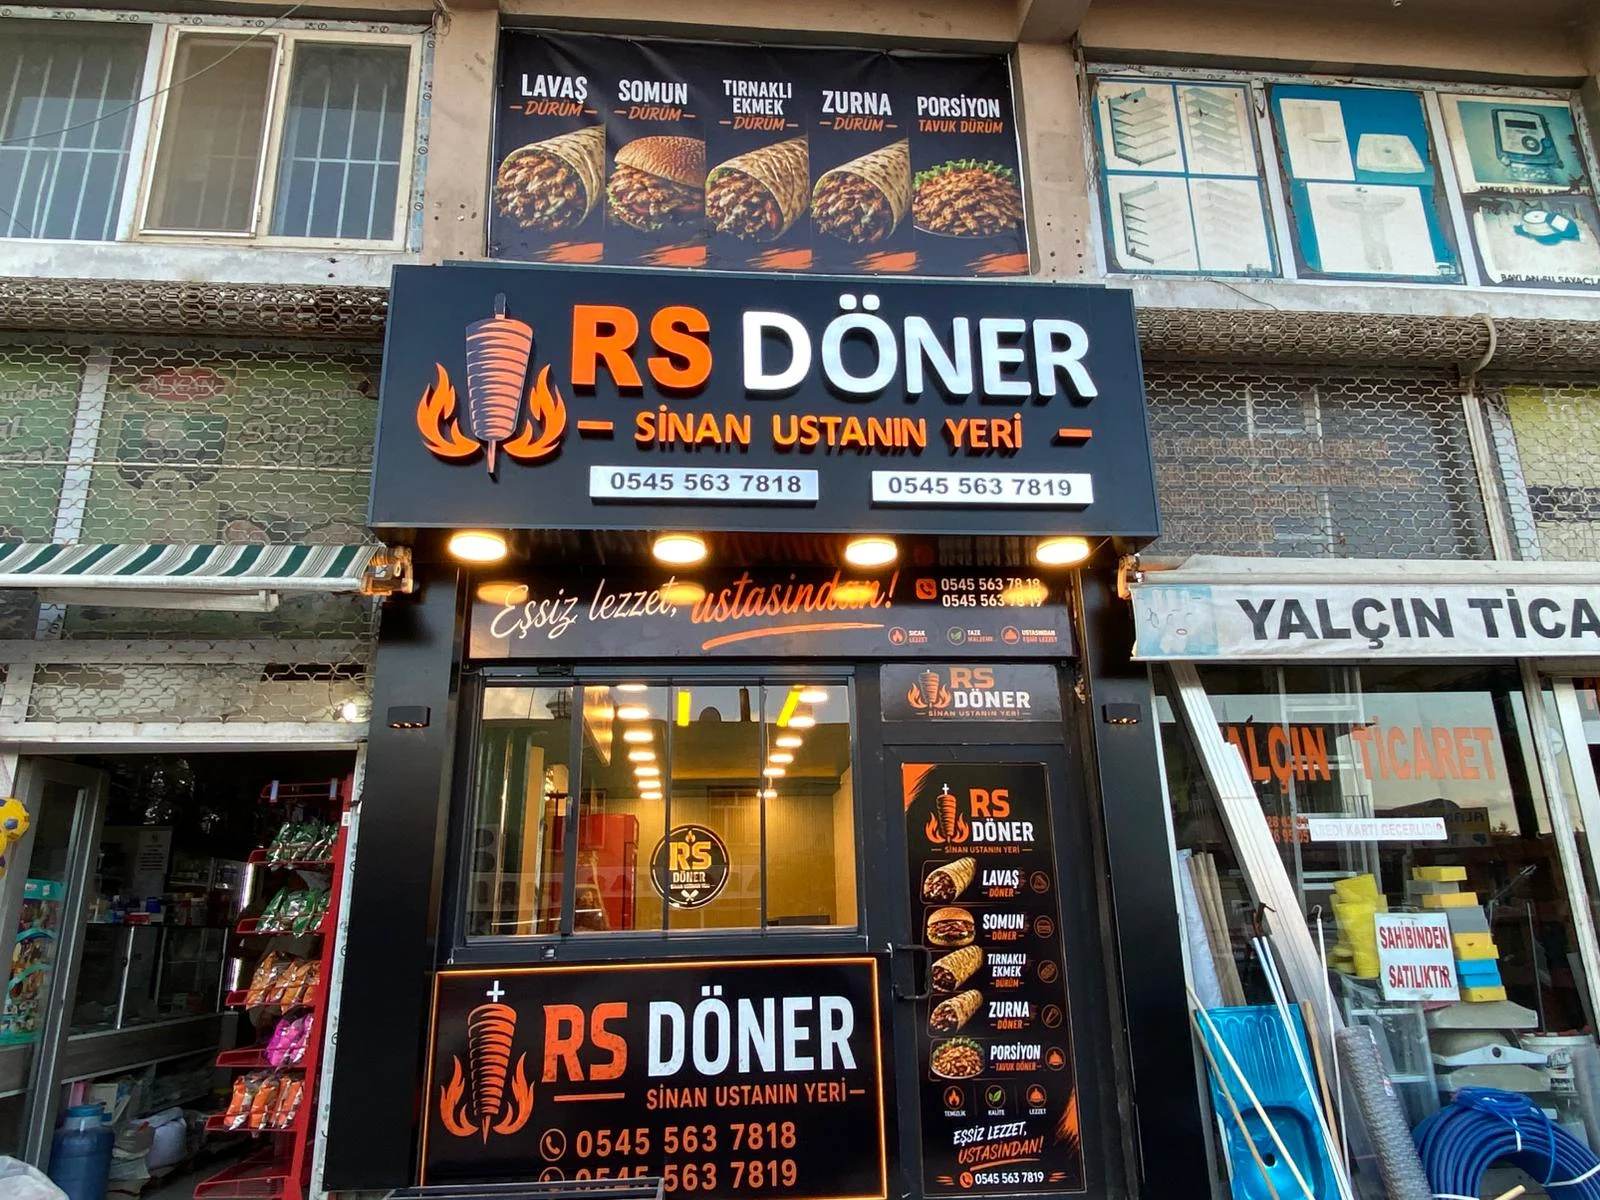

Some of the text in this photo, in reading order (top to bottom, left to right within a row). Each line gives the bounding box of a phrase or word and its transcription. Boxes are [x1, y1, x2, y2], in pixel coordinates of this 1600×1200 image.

[522, 74, 587, 104] LAVAŞ
[618, 79, 688, 105] SOMUN
[723, 80, 792, 99] TIRNAKLI
[525, 100, 583, 117] DÜRÜM
[628, 104, 681, 121] DÜRÜM
[733, 97, 783, 115] EKMEK
[822, 90, 892, 116] ZURNA
[917, 93, 1000, 118] PORSİYON
[734, 115, 784, 132] DÜRÜM
[834, 115, 883, 132] DÜRÜM
[919, 118, 1003, 134] TAVUK DÜRÜM
[571, 293, 1098, 398] RS DÖNER
[634, 404, 1022, 449] SİNAN USTANIN YERİ
[611, 472, 801, 493] 0545 563 7818
[888, 477, 1072, 497] 0545 563 7819
[941, 578, 975, 591] 0545
[979, 578, 1003, 591] 563
[490, 585, 577, 640] Eşsiz
[588, 575, 677, 621] lezzet,
[942, 594, 976, 607] 0545
[980, 594, 1005, 607] 563
[1237, 597, 1454, 650] YALÇIN
[950, 667, 995, 689] RS
[954, 688, 1031, 709] DÖNER
[928, 708, 956, 717] SİNAN
[1351, 716, 1496, 781] TİCARET
[969, 788, 1011, 818] RS
[971, 818, 1035, 843] DÖNER
[669, 841, 712, 871] RS
[673, 871, 706, 883] DÖNER
[982, 869, 1019, 889] LAVAŞ
[989, 887, 1014, 897] DÖNER
[982, 913, 1025, 930] SOMUN
[992, 930, 1017, 941] DÖNER
[1380, 921, 1449, 949] SAHİBİNDEN
[987, 953, 1027, 965] TIRNAKLI
[992, 965, 1022, 977] EKMEK
[1389, 965, 1453, 989] SATILIKTIR
[988, 1001, 1030, 1018] ZURNA
[997, 1018, 1023, 1030] DÖNER
[542, 985, 857, 1084] RS DÖNER
[990, 1041, 1041, 1061] PORSİYON
[646, 1077, 846, 1110] SİNAN USTANIN YERİ
[576, 1121, 797, 1158] 0545 563 7818
[953, 1121, 1027, 1147] EŞSİZ LEZZET,
[664, 1162, 717, 1193] 563
[730, 1159, 797, 1189] 7819
[974, 1171, 1044, 1185] 0545 563 7819
